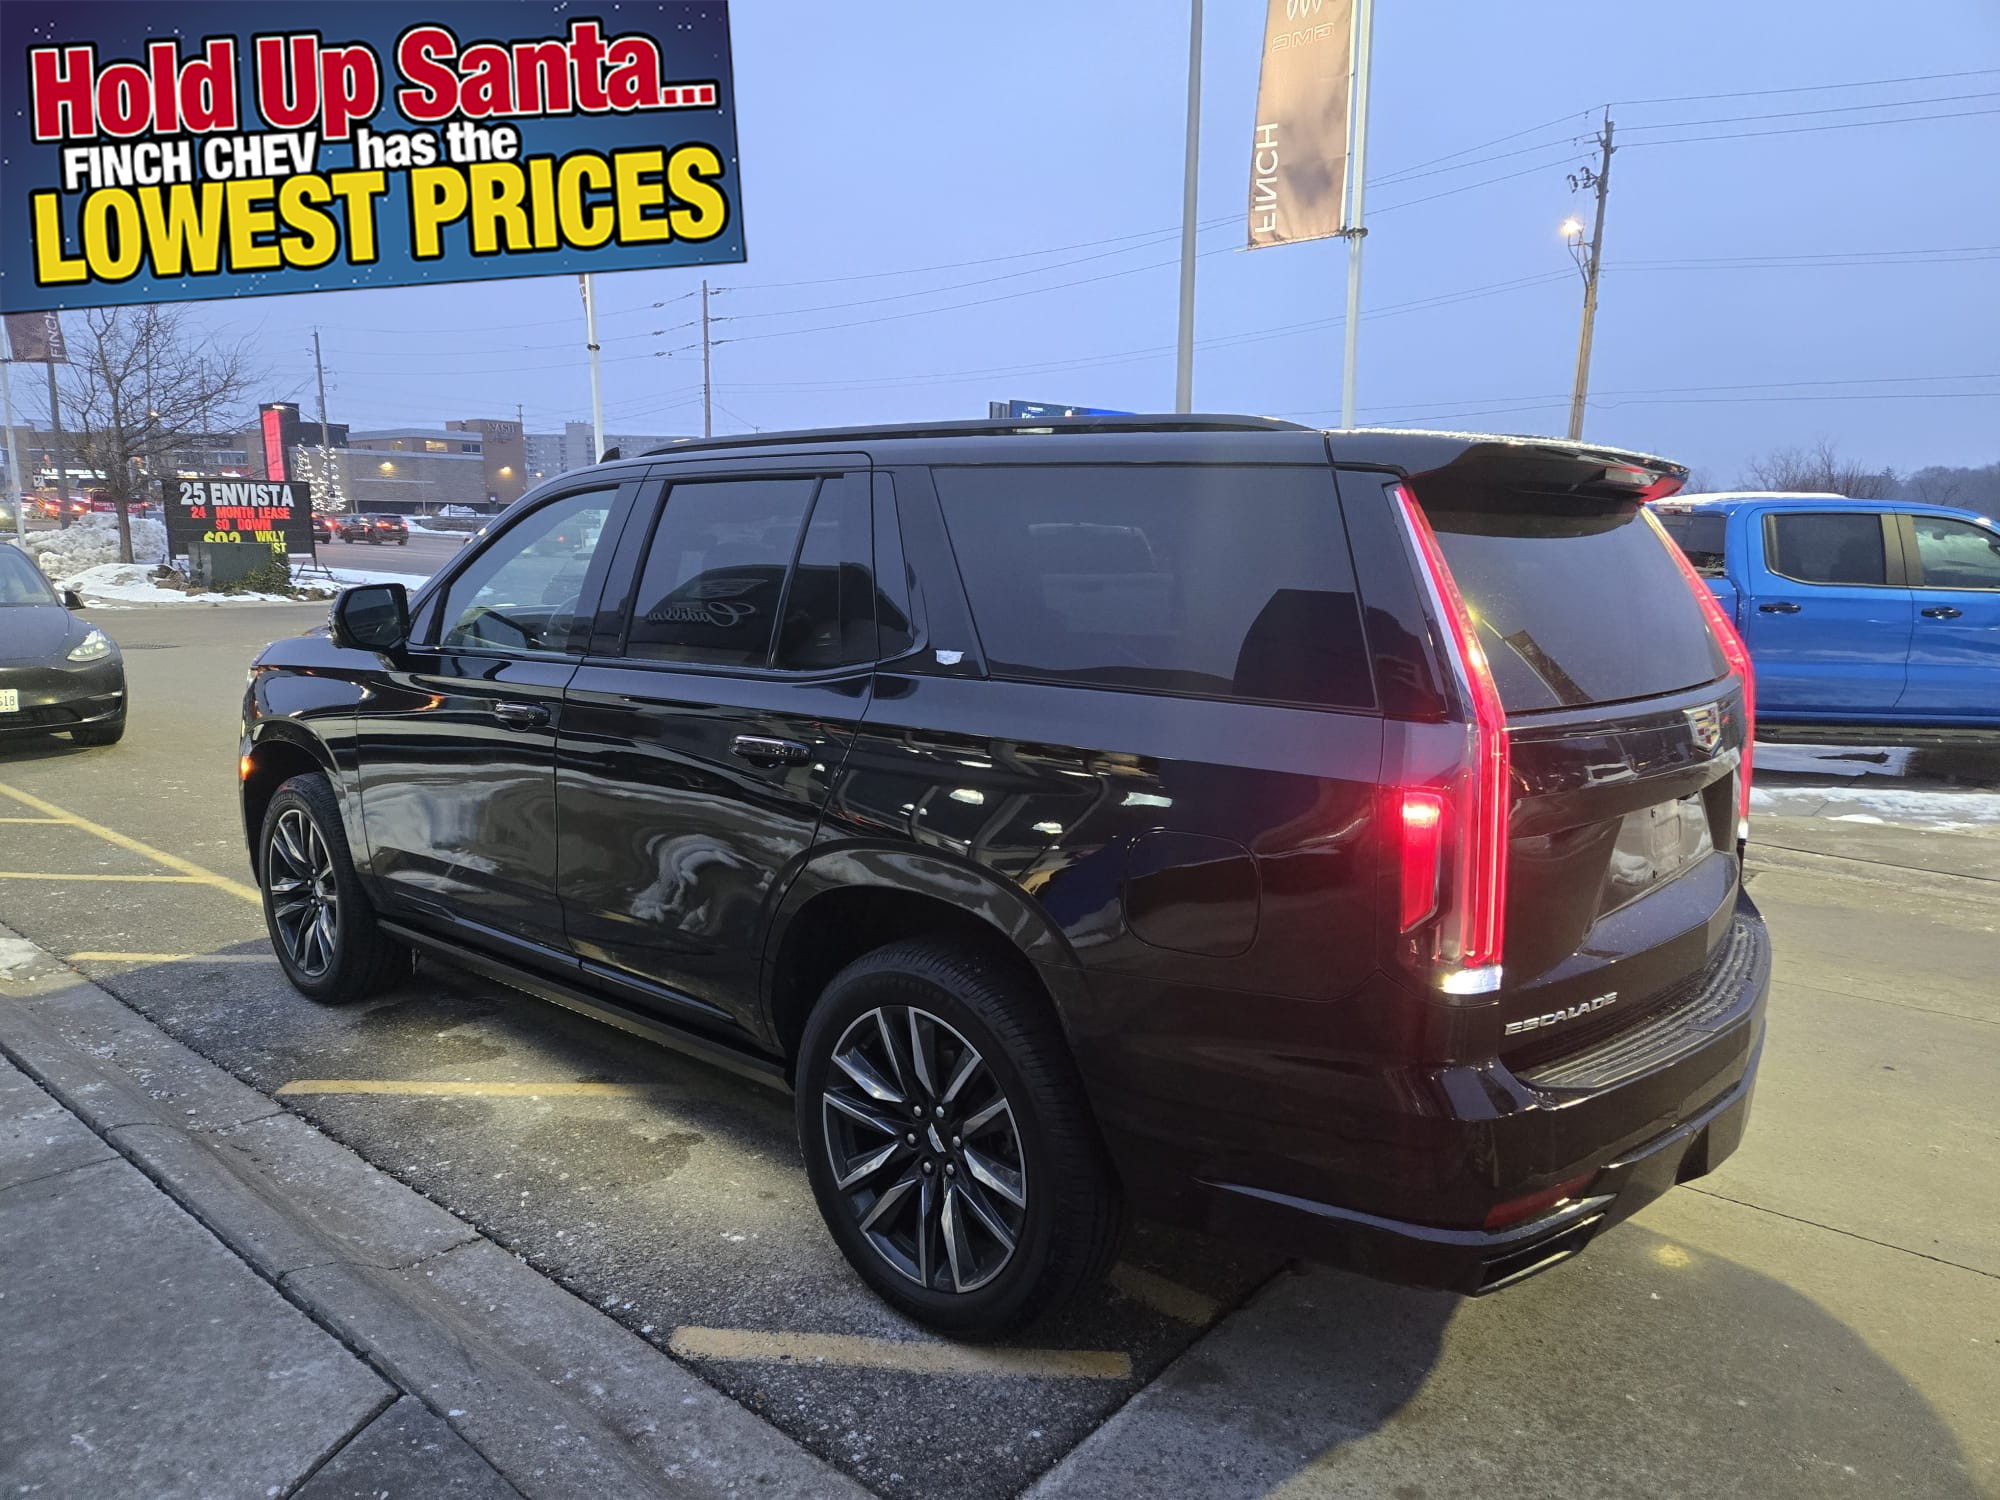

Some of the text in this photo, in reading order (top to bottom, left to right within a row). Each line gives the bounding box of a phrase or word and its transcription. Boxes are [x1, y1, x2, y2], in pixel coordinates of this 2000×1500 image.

[180, 482, 295, 507] 25 ENVISTA
[191, 507, 290, 519] 24 MONTH LEASE
[237, 519, 271, 530] DOWN
[255, 530, 285, 542] WKLY
[1505, 991, 1618, 1036] ESCALADE
